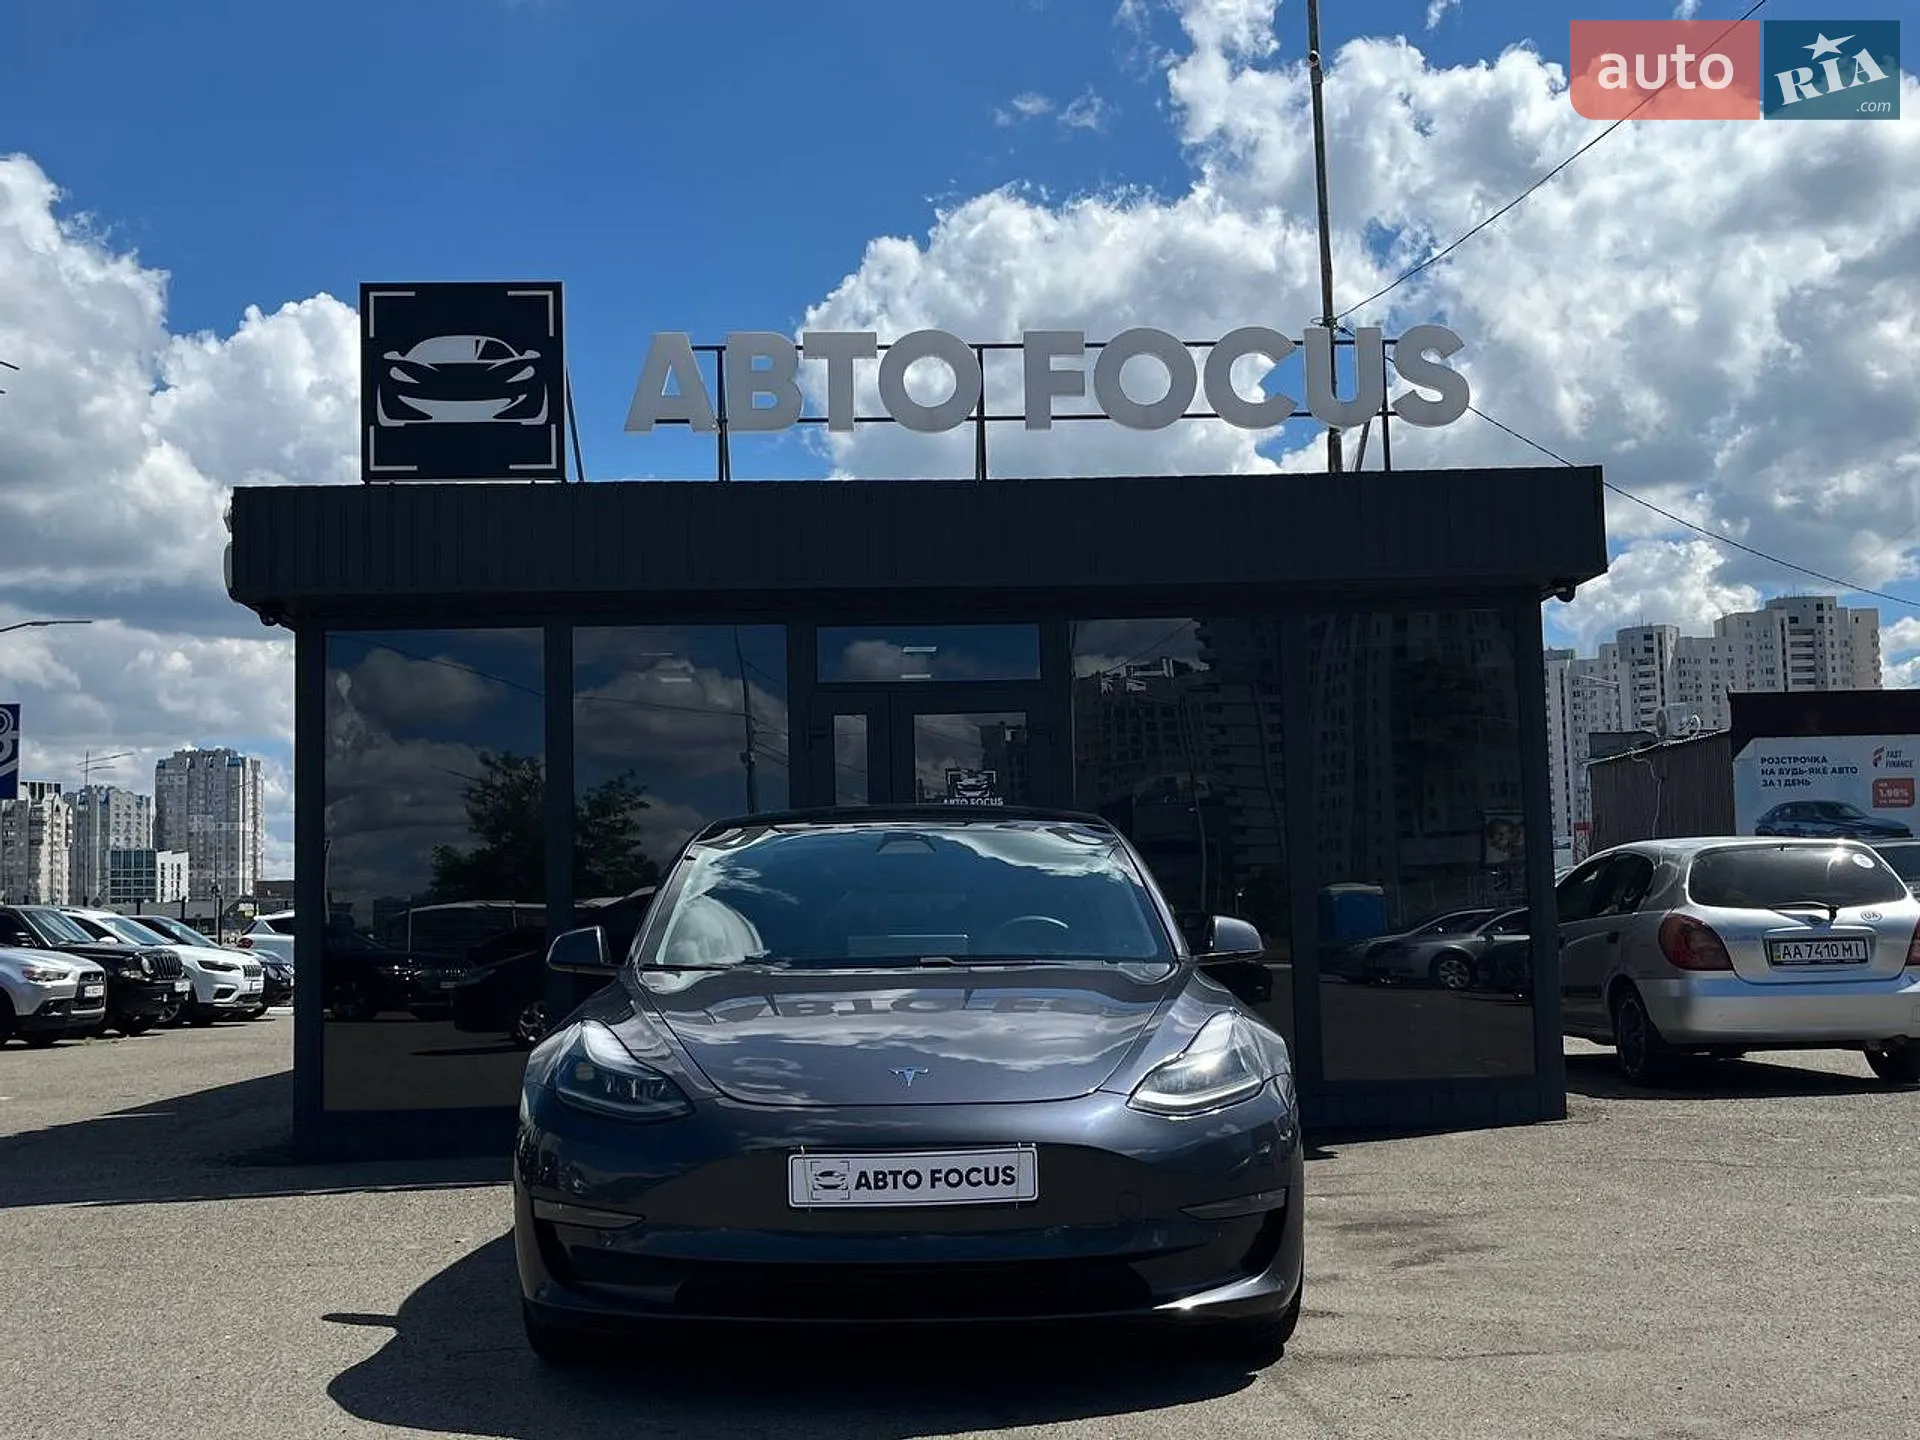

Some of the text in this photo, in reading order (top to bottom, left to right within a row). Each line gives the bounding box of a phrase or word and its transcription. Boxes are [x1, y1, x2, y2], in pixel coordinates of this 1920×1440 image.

[624, 326, 1471, 433] АВТО FOCUS
[1760, 755, 1828, 765] РОЗСТРОЧКА
[1761, 767, 1776, 776] НА
[1831, 766, 1858, 775] АВТО
[1782, 944, 1803, 959] AA
[1806, 943, 1839, 959] 7410
[854, 1165, 1016, 1191] АВТО FOCUS
